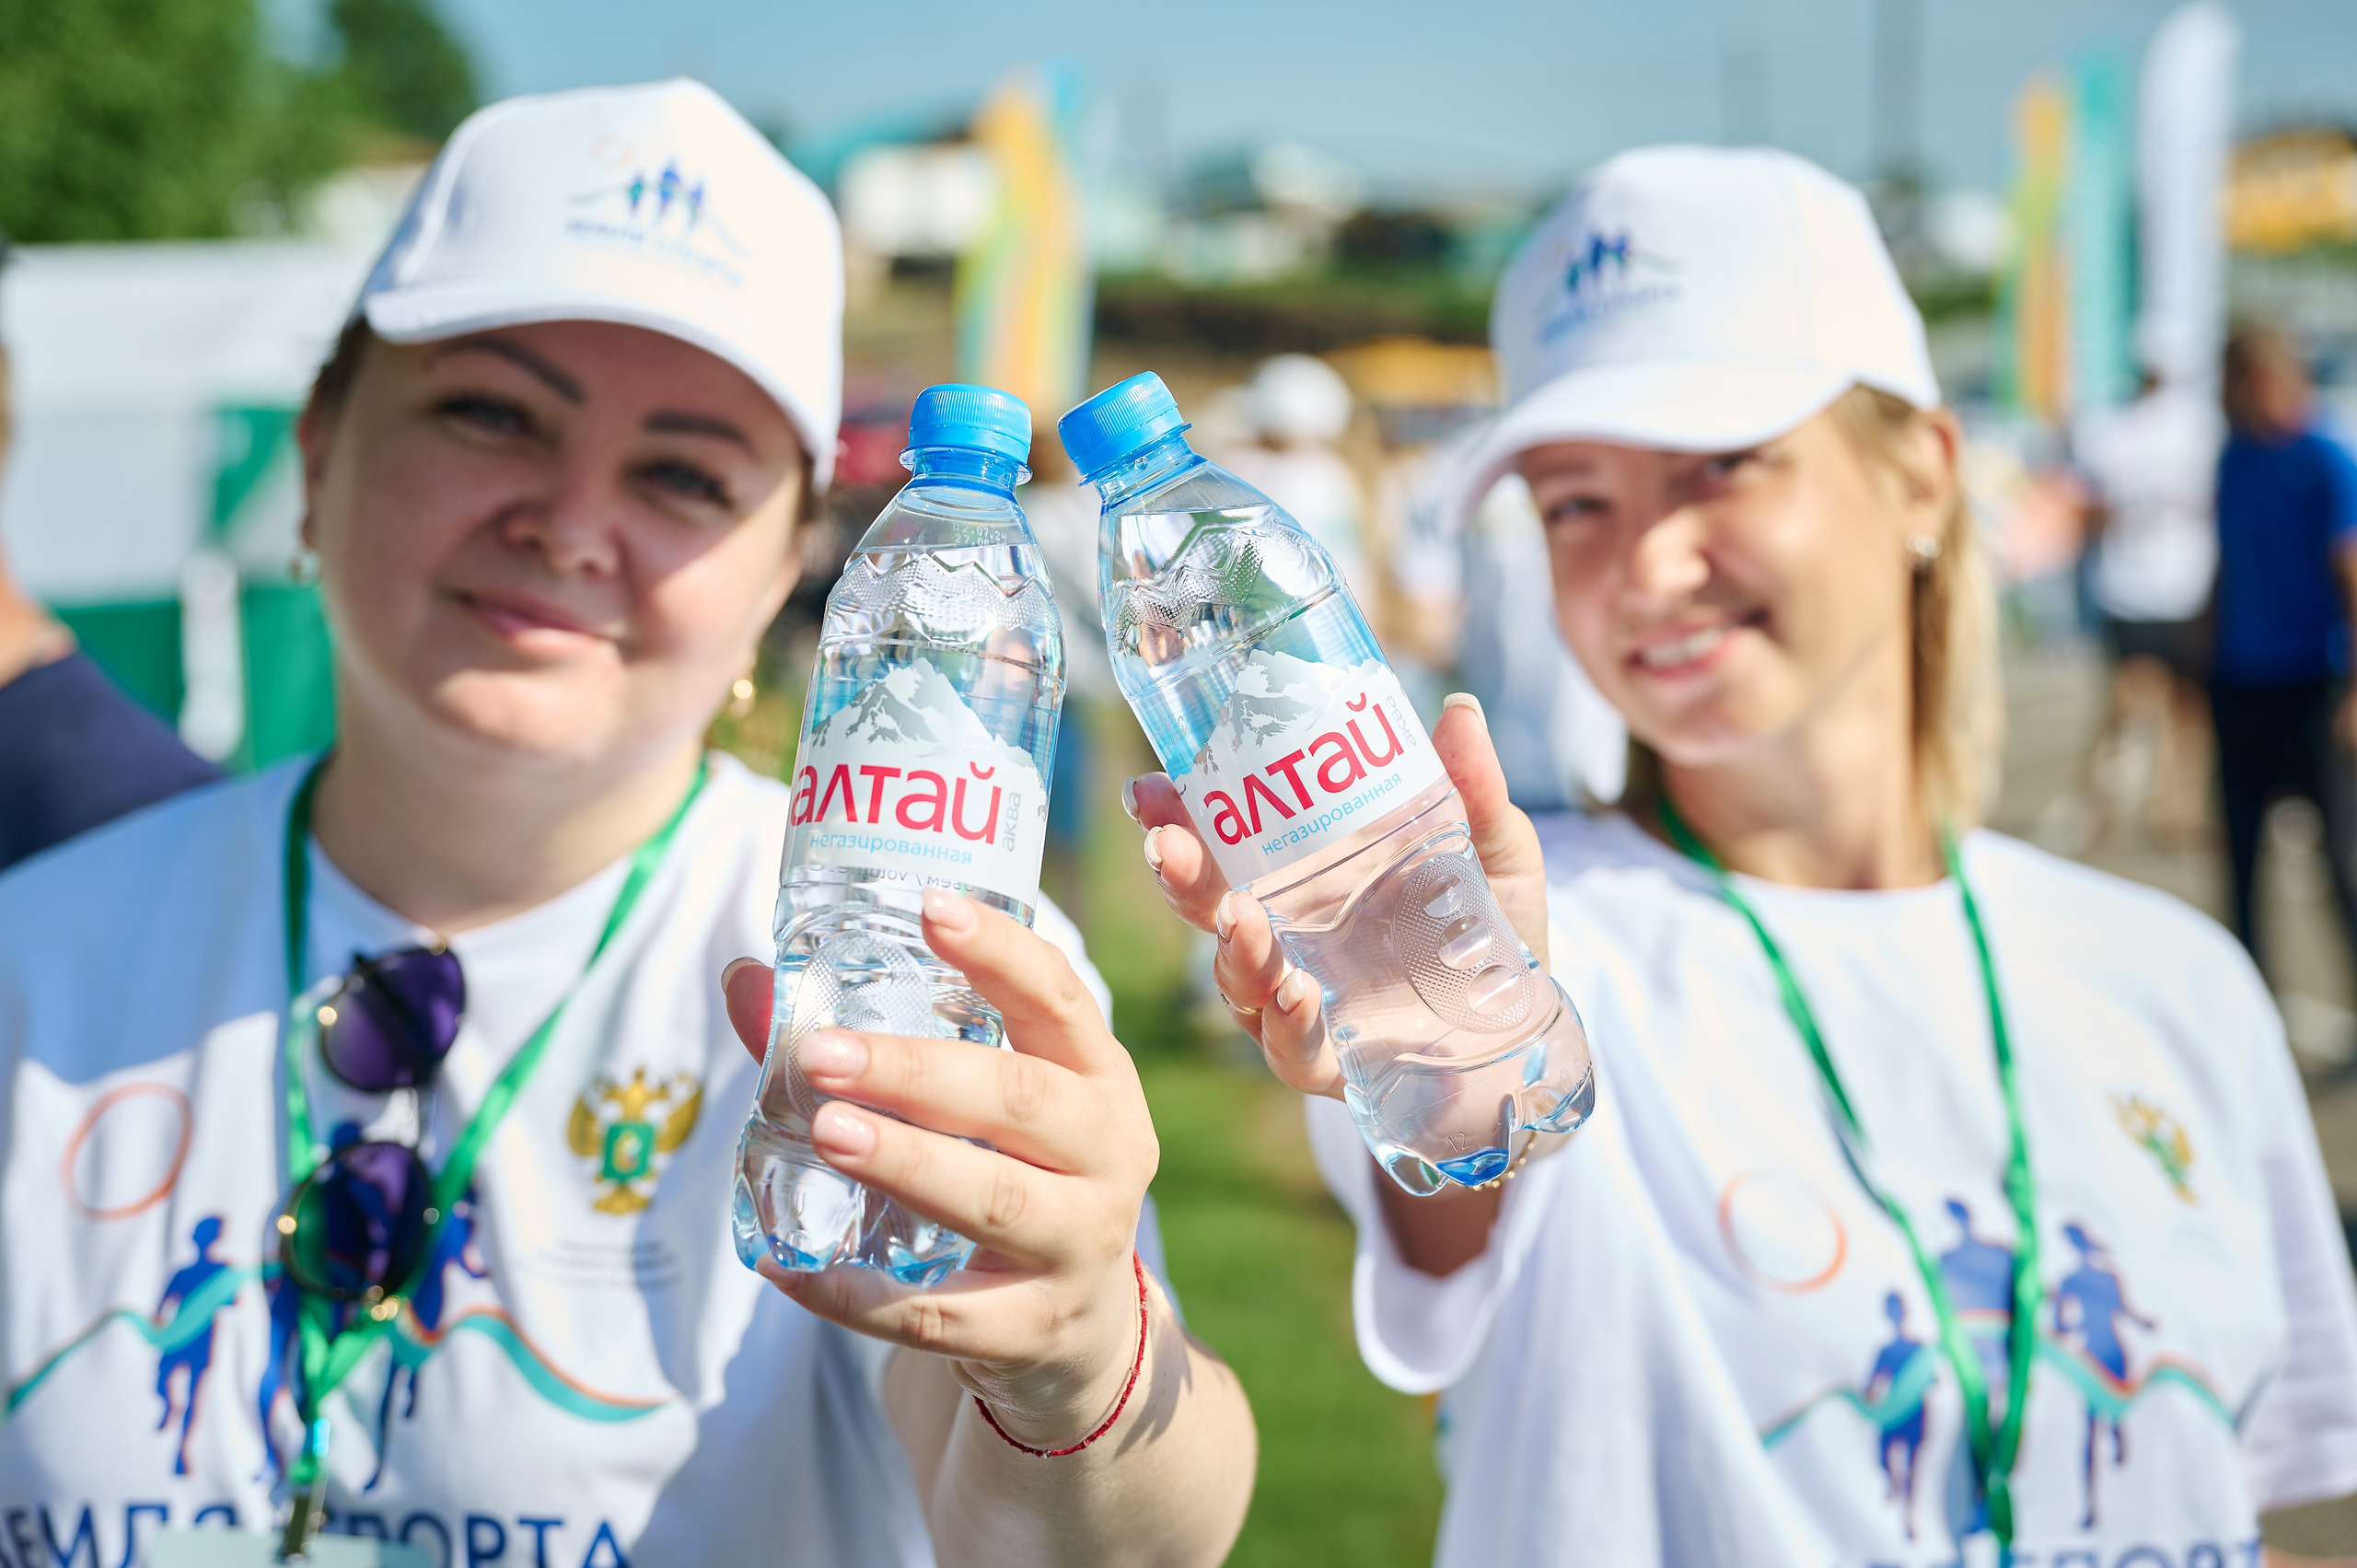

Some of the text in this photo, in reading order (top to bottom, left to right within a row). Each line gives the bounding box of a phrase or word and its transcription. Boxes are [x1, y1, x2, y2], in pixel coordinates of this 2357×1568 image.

[1385, 695, 1417, 747] аква
[1203, 692, 1404, 845] алтай
[790, 761, 1002, 844] алтай
[1002, 792, 1021, 853] аква
[1261, 772, 1402, 855] негазированная
[810, 834, 972, 865] негазированная
[1446, 1132, 1471, 1152] 12
